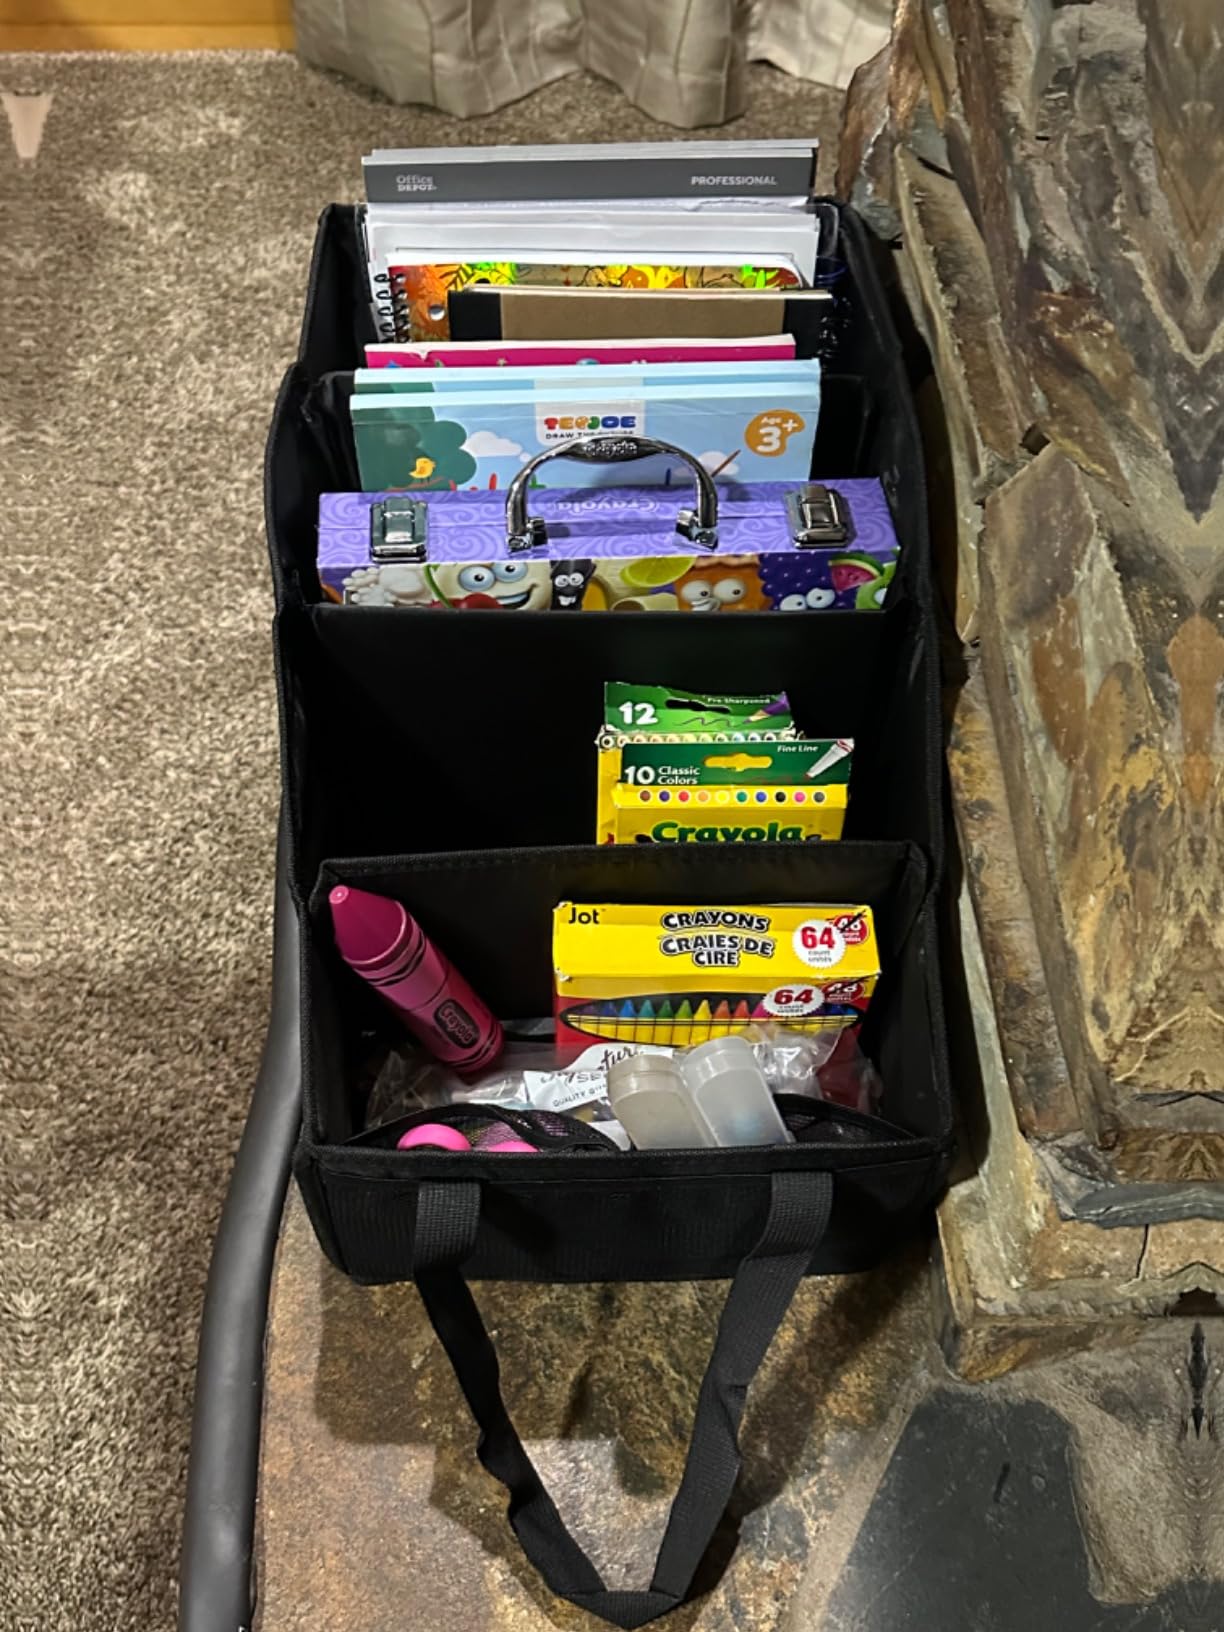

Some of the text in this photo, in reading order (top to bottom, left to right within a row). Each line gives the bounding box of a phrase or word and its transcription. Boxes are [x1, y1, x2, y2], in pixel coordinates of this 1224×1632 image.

[396, 174, 433, 184] Office
[691, 176, 777, 185] PROFESSIONAL
[558, 497, 657, 513] Crayola
[619, 702, 657, 725] 12
[798, 744, 818, 752] Line
[624, 765, 655, 785] 10
[658, 766, 700, 775] Classic
[658, 775, 698, 785] Colors
[651, 821, 803, 842] Crayola
[568, 906, 600, 925] Jot
[662, 911, 769, 931] CRAYONS
[661, 934, 773, 956] CRAIES DE
[801, 926, 835, 949] 64
[694, 950, 738, 965] CIRE
[774, 988, 814, 1005] 64
[552, 1090, 586, 1107] QUALITY
